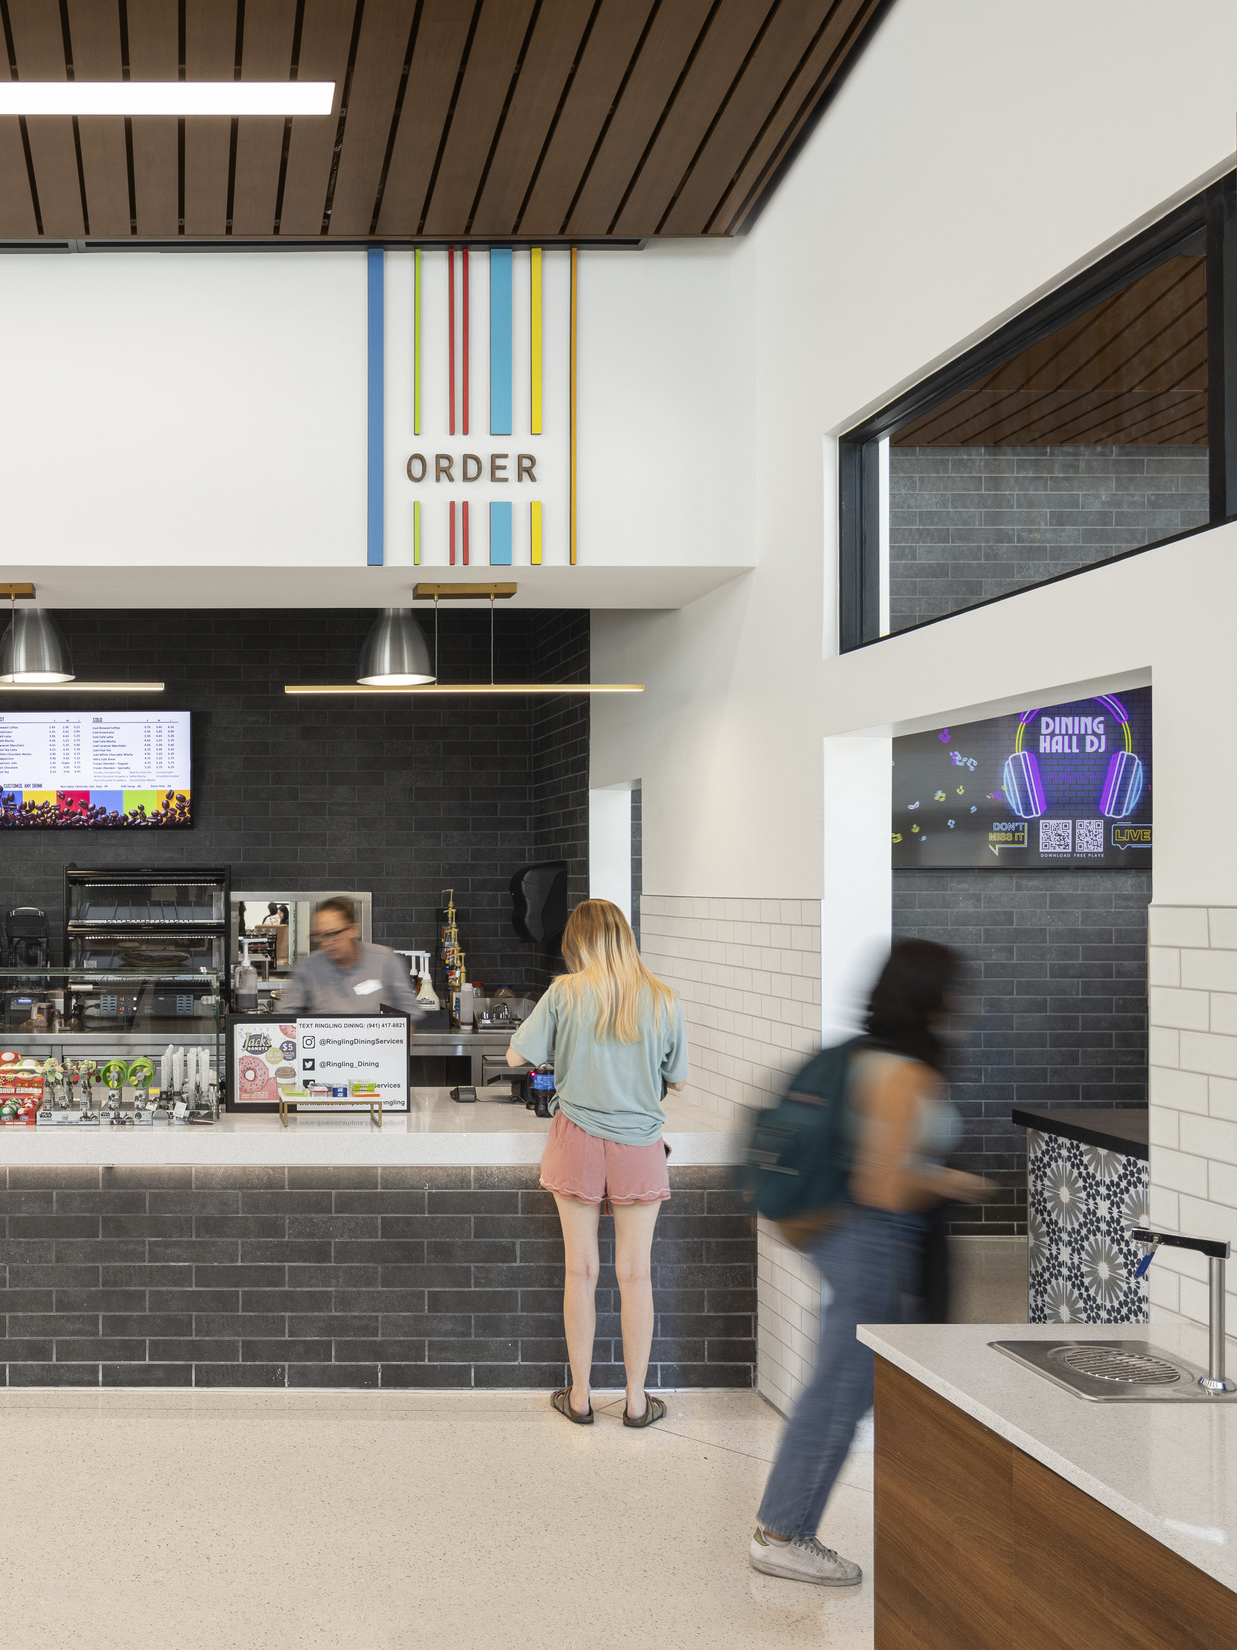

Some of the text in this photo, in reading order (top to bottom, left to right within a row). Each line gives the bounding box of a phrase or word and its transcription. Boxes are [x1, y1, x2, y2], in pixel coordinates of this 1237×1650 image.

[406, 452, 537, 483] ORDER
[1040, 716, 1105, 735] DINING
[1039, 734, 1107, 753] HALL DJ
[992, 822, 1025, 831] DON'T
[988, 832, 1025, 842] MISS IT
[1114, 830, 1151, 842] LIVE
[241, 1032, 272, 1052] Jack's
[282, 1043, 293, 1051] $5
